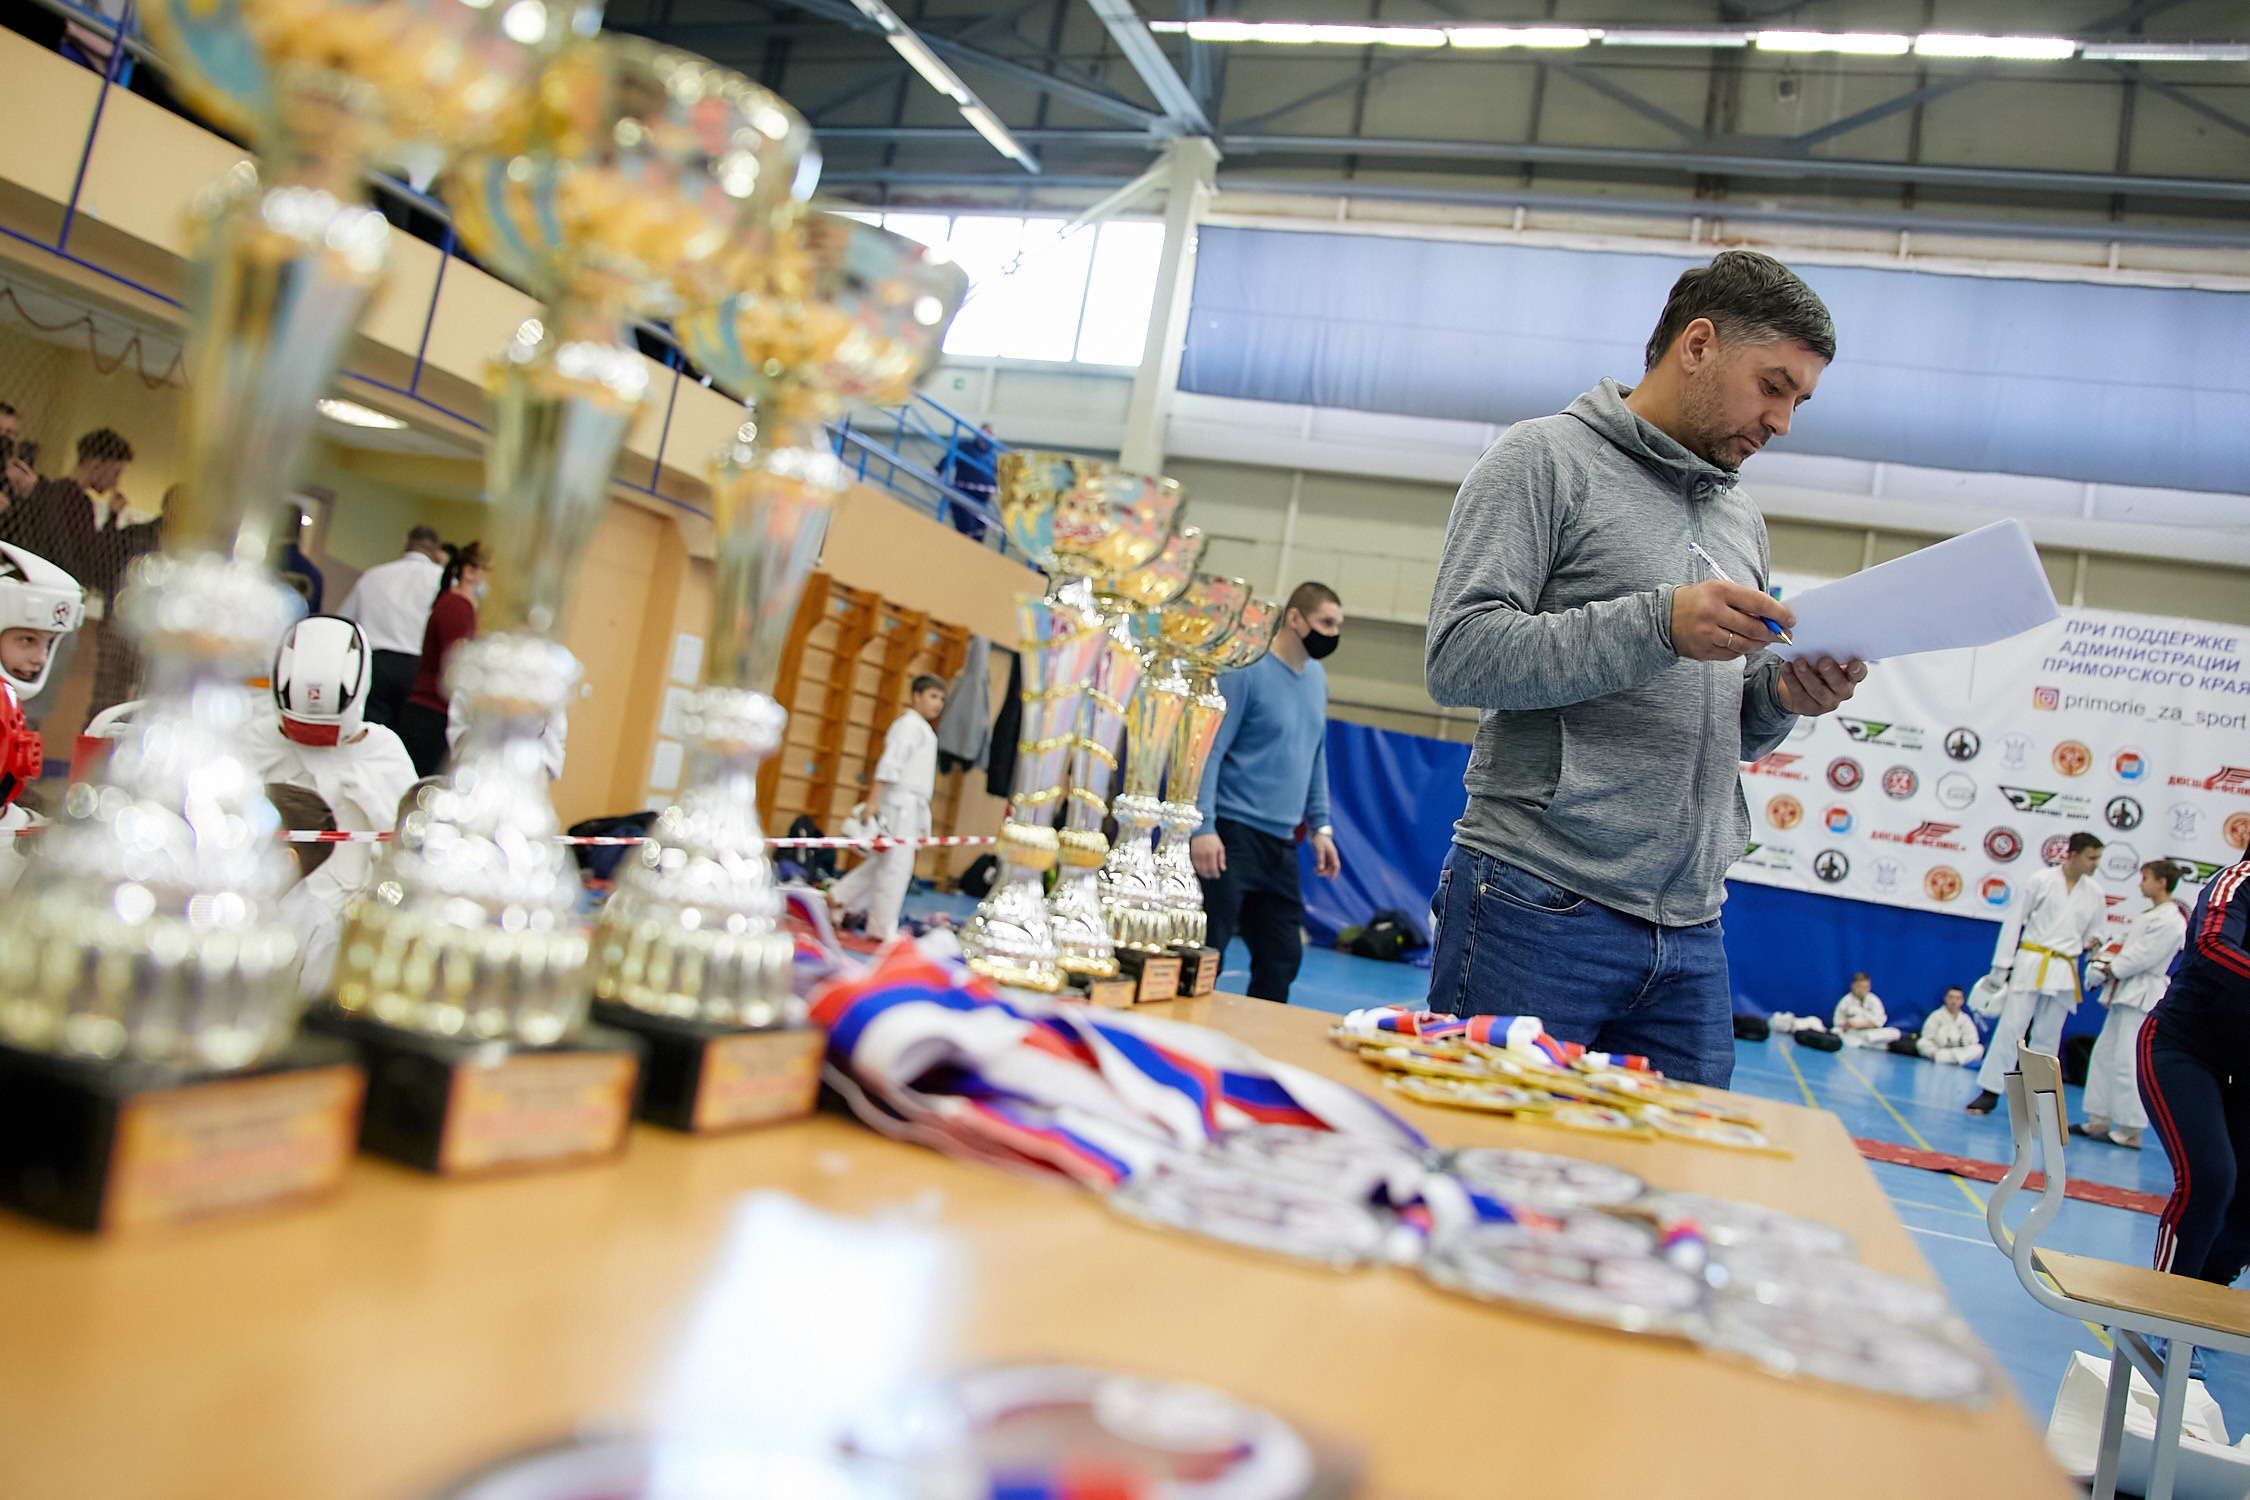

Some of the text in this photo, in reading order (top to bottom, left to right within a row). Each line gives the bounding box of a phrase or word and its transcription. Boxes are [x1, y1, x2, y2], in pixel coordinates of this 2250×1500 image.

[2065, 619, 2239, 653] ПРИ ПОДДЕРЖКЕ
[2058, 639, 2241, 673] АДМИНИСТРАЦИИ
[2042, 657, 2250, 696] ПРИМОРСКОГО КРАЯ
[2064, 693, 2247, 730] primorie_za_sport
